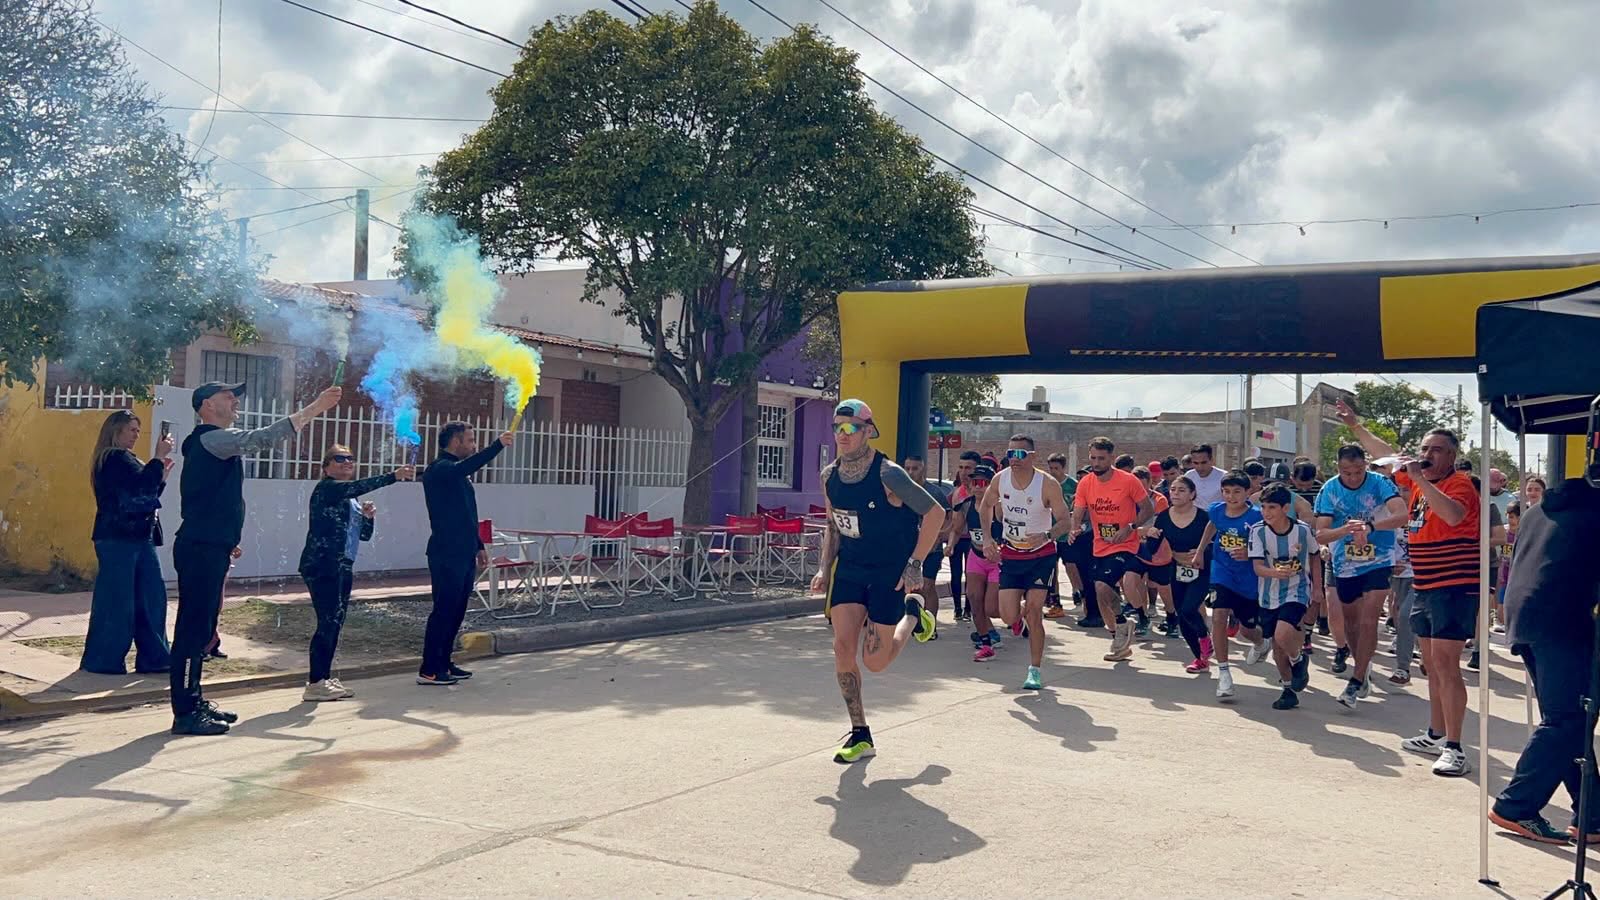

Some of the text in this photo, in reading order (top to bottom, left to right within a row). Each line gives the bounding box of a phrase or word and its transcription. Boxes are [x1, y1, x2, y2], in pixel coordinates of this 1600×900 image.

[836, 515, 852, 530] 33
[1008, 525, 1019, 537] 21
[1221, 535, 1244, 547] 835
[1346, 545, 1372, 557] 439
[1181, 567, 1194, 578] 20
